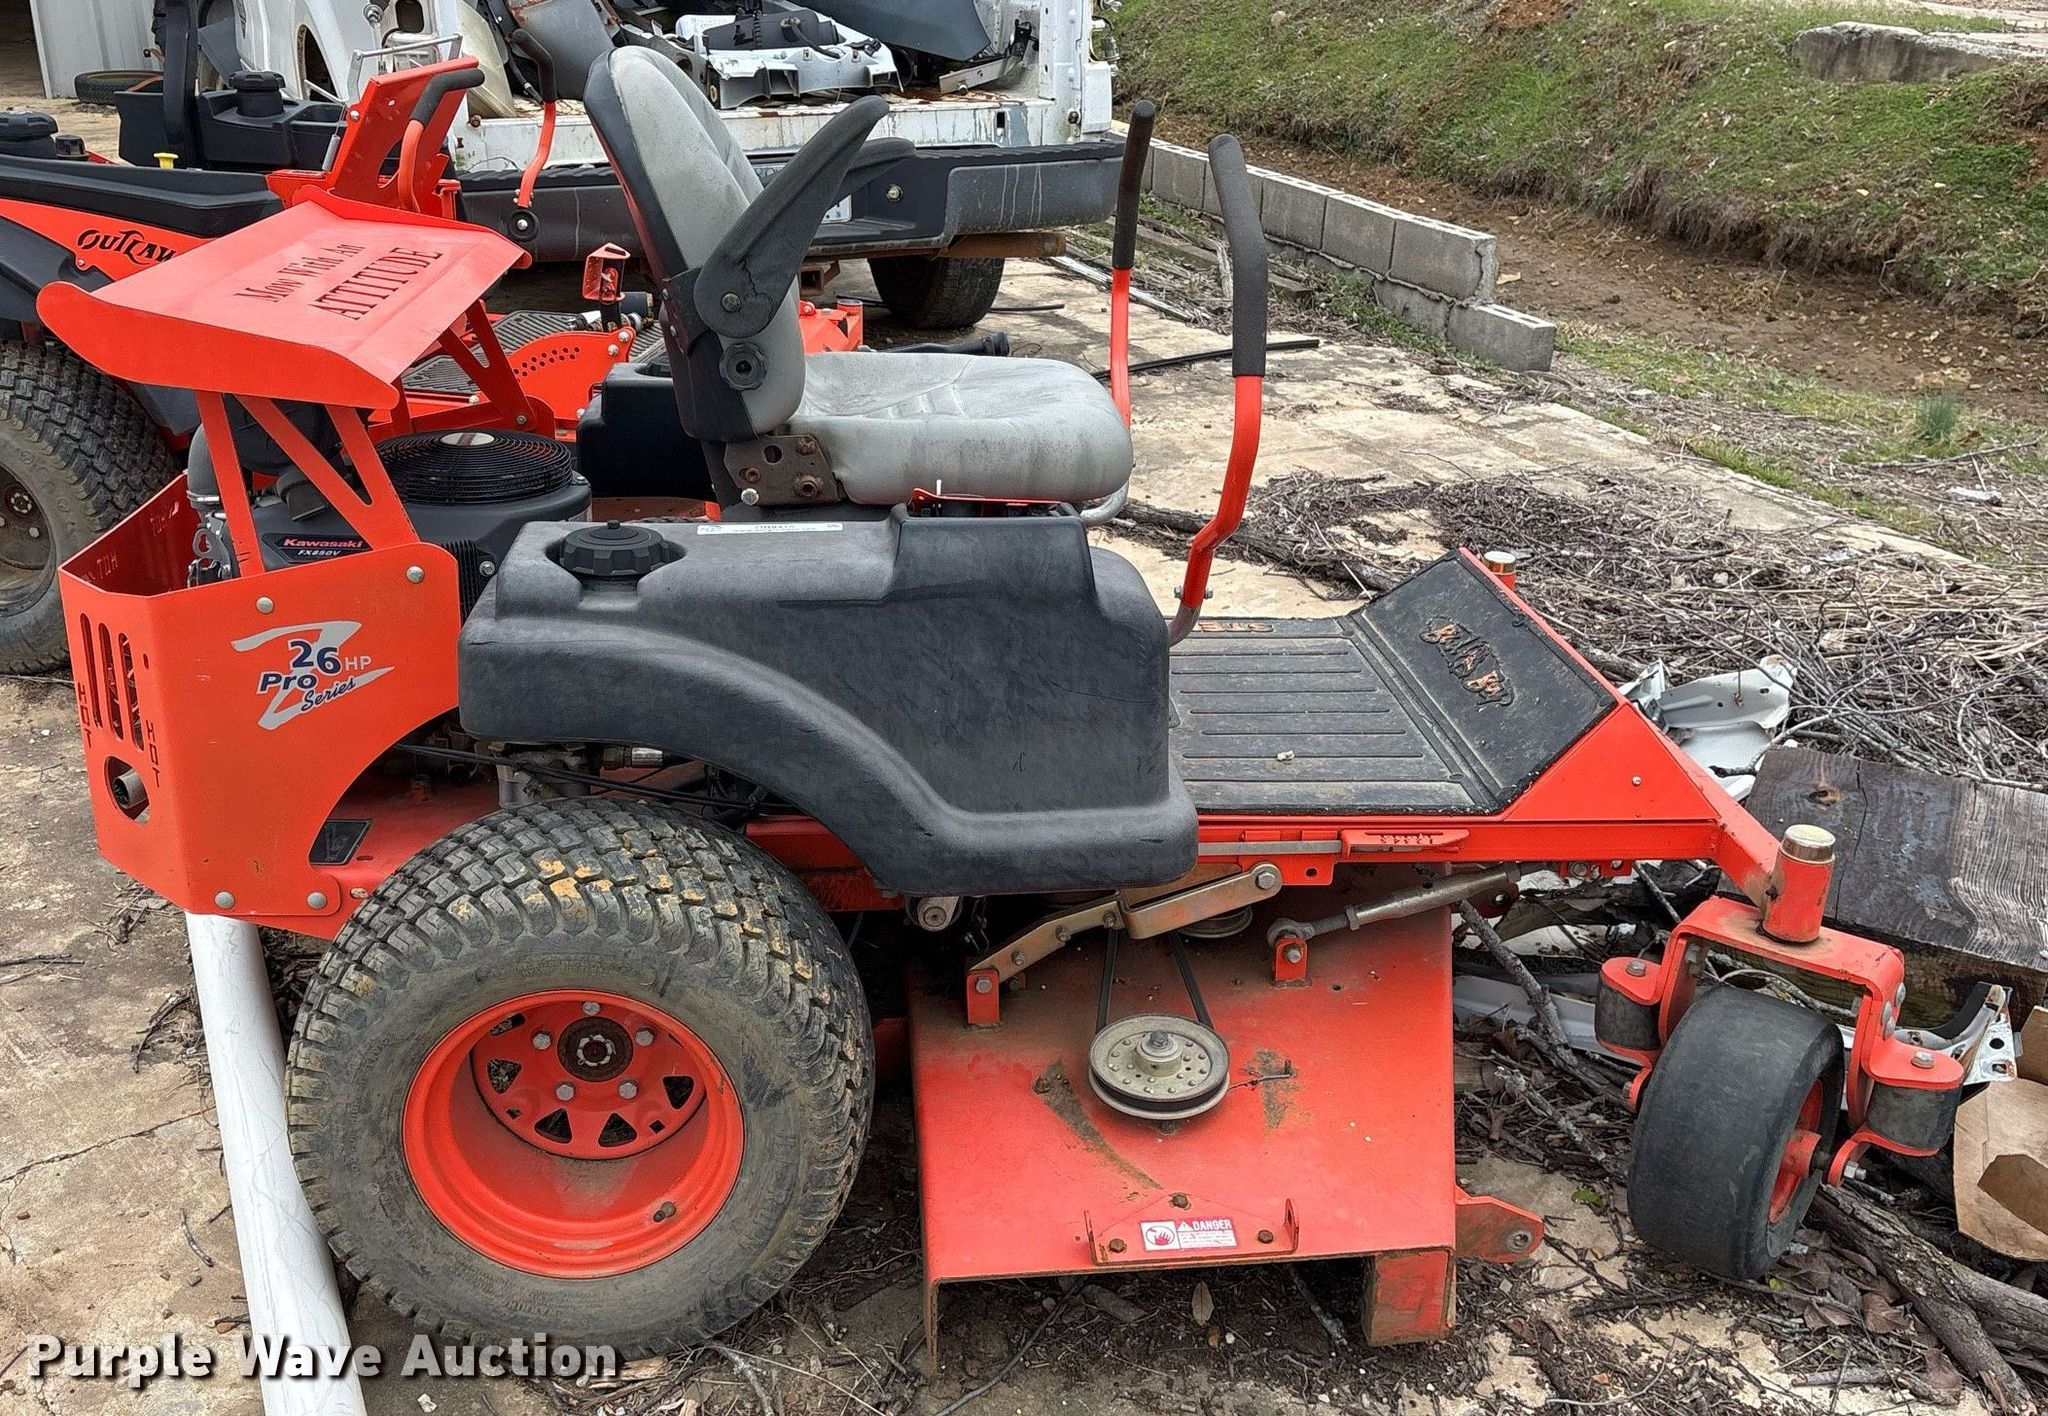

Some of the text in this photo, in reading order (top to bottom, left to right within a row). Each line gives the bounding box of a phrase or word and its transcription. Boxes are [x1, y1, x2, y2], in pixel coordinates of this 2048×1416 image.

[233, 244, 366, 303] Mow With An
[307, 247, 444, 320] ATTITUDE
[283, 538, 363, 548] Kawasaki
[287, 638, 372, 675] 26 HP
[257, 671, 318, 695] Pro
[300, 676, 357, 713] Series
[78, 682, 92, 749] HOT
[146, 719, 160, 788] HOT
[1191, 1219, 1232, 1231] DANGER
